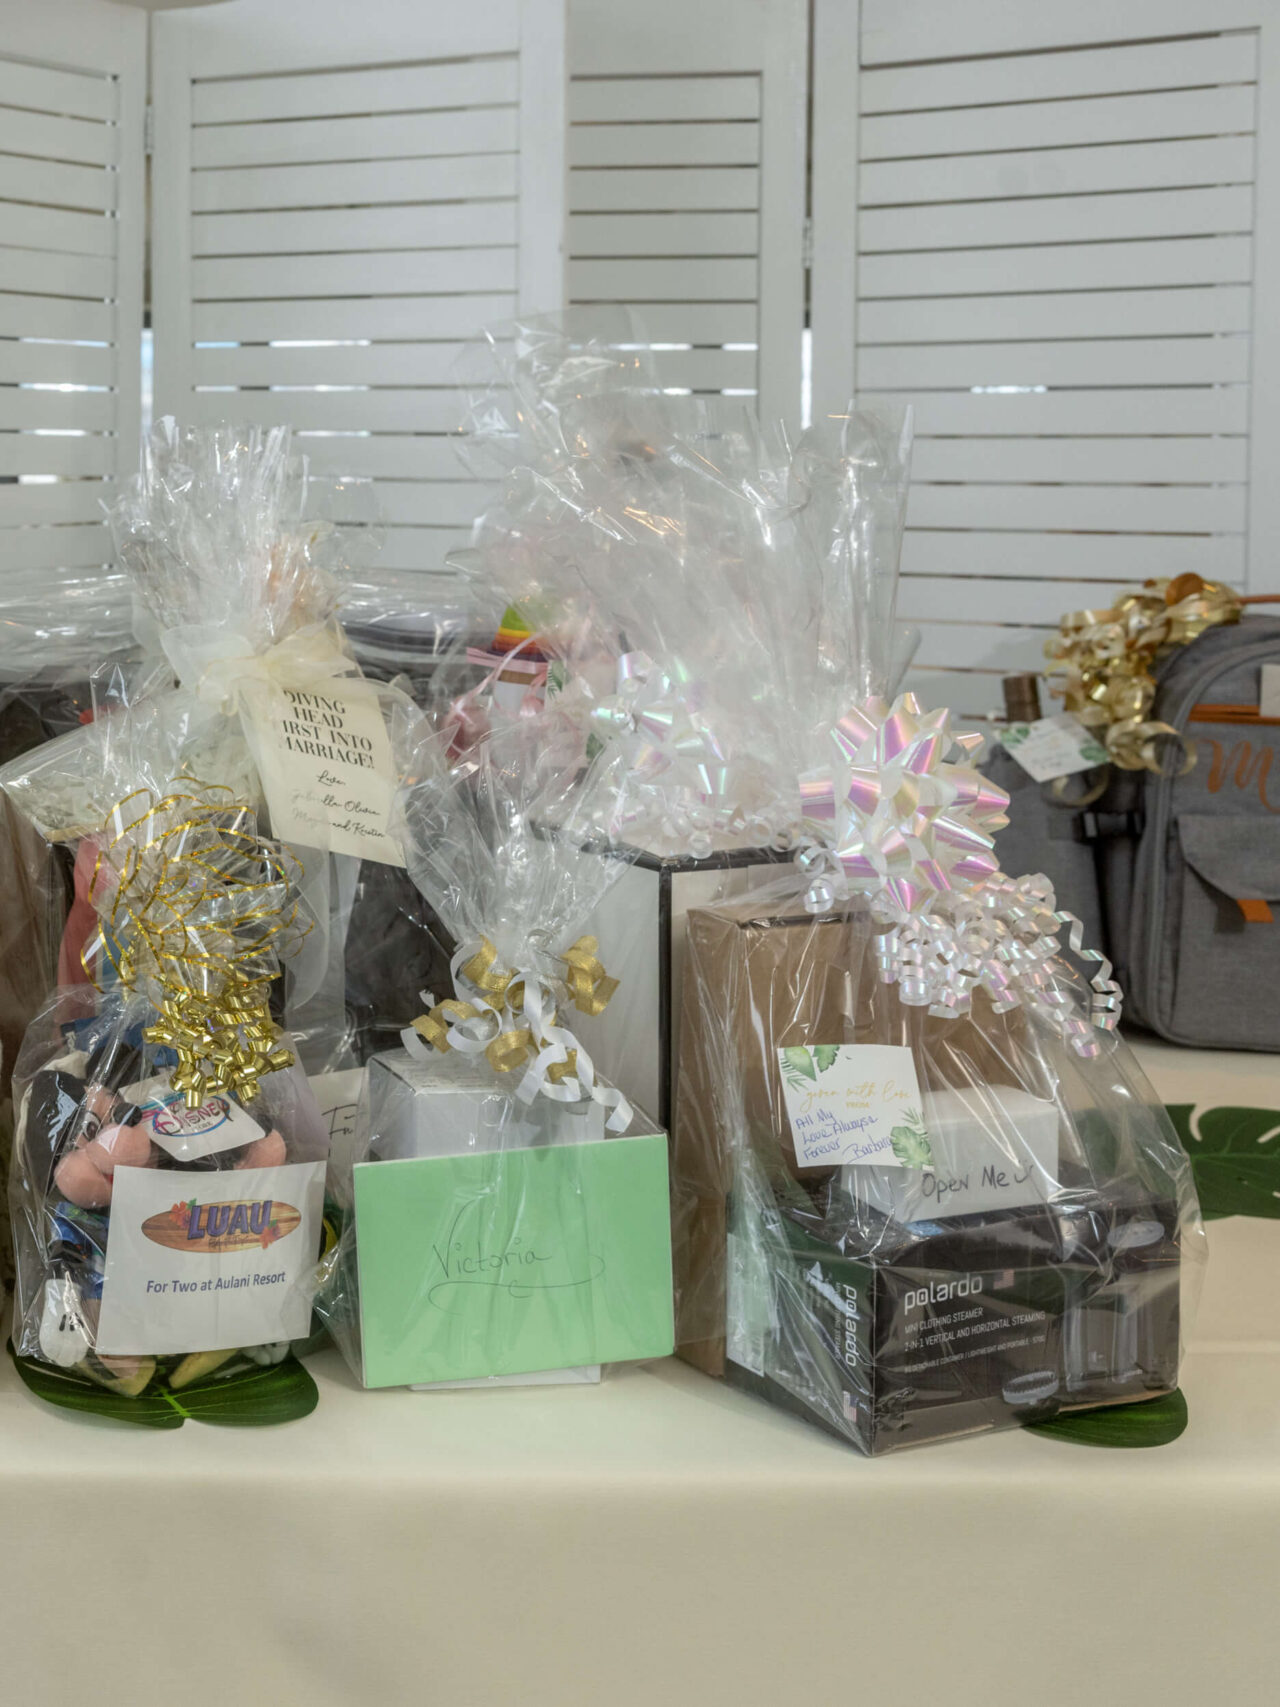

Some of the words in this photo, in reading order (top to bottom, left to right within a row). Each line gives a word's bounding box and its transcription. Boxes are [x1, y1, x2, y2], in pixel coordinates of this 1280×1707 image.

[293, 706, 344, 729] HEAD
[282, 719, 322, 740] IRST
[329, 729, 373, 752] INTO
[328, 819, 351, 832] and
[799, 1088, 839, 1113] given
[846, 1080, 877, 1098] with
[882, 1079, 912, 1103] love
[802, 1129, 833, 1145] Love
[981, 1164, 1010, 1189] Me
[187, 1200, 273, 1240] LUAU
[146, 1280, 168, 1294] For
[172, 1279, 197, 1293] Two
[200, 1280, 212, 1291] at
[214, 1274, 251, 1290] Aulani
[252, 1271, 286, 1285] Resort
[904, 1272, 983, 1316] polardo
[843, 1284, 861, 1367] polardo
[919, 1314, 952, 1331] CLOTHING
[952, 1307, 984, 1323] STEAMER
[925, 1331, 956, 1346] VERTICAL
[956, 1327, 970, 1339] AND
[971, 1318, 1011, 1335] HORIZONTAL
[1012, 1310, 1046, 1327] STEAMING
